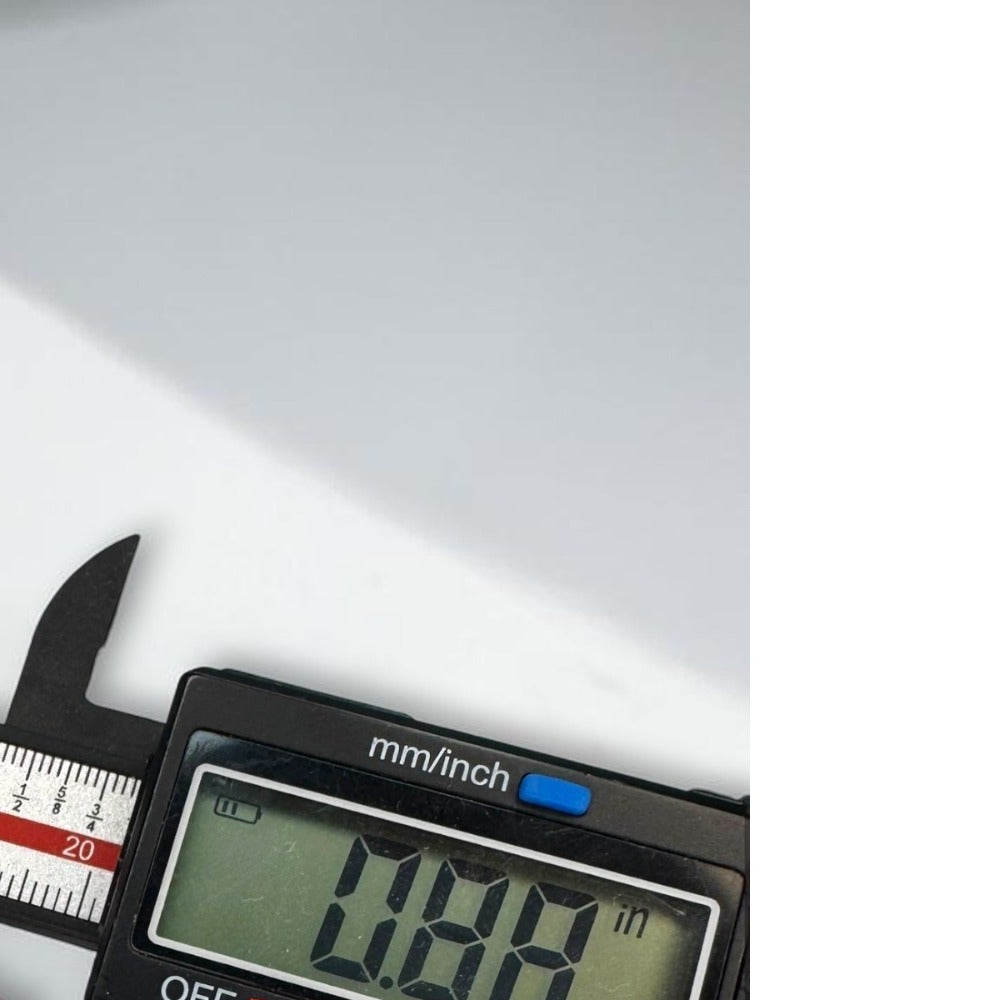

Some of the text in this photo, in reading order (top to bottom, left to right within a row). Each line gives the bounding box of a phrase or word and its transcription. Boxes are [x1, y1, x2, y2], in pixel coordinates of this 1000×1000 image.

[367, 735, 511, 793] mm/inch
[62, 835, 95, 861] 20
[612, 902, 651, 940] in
